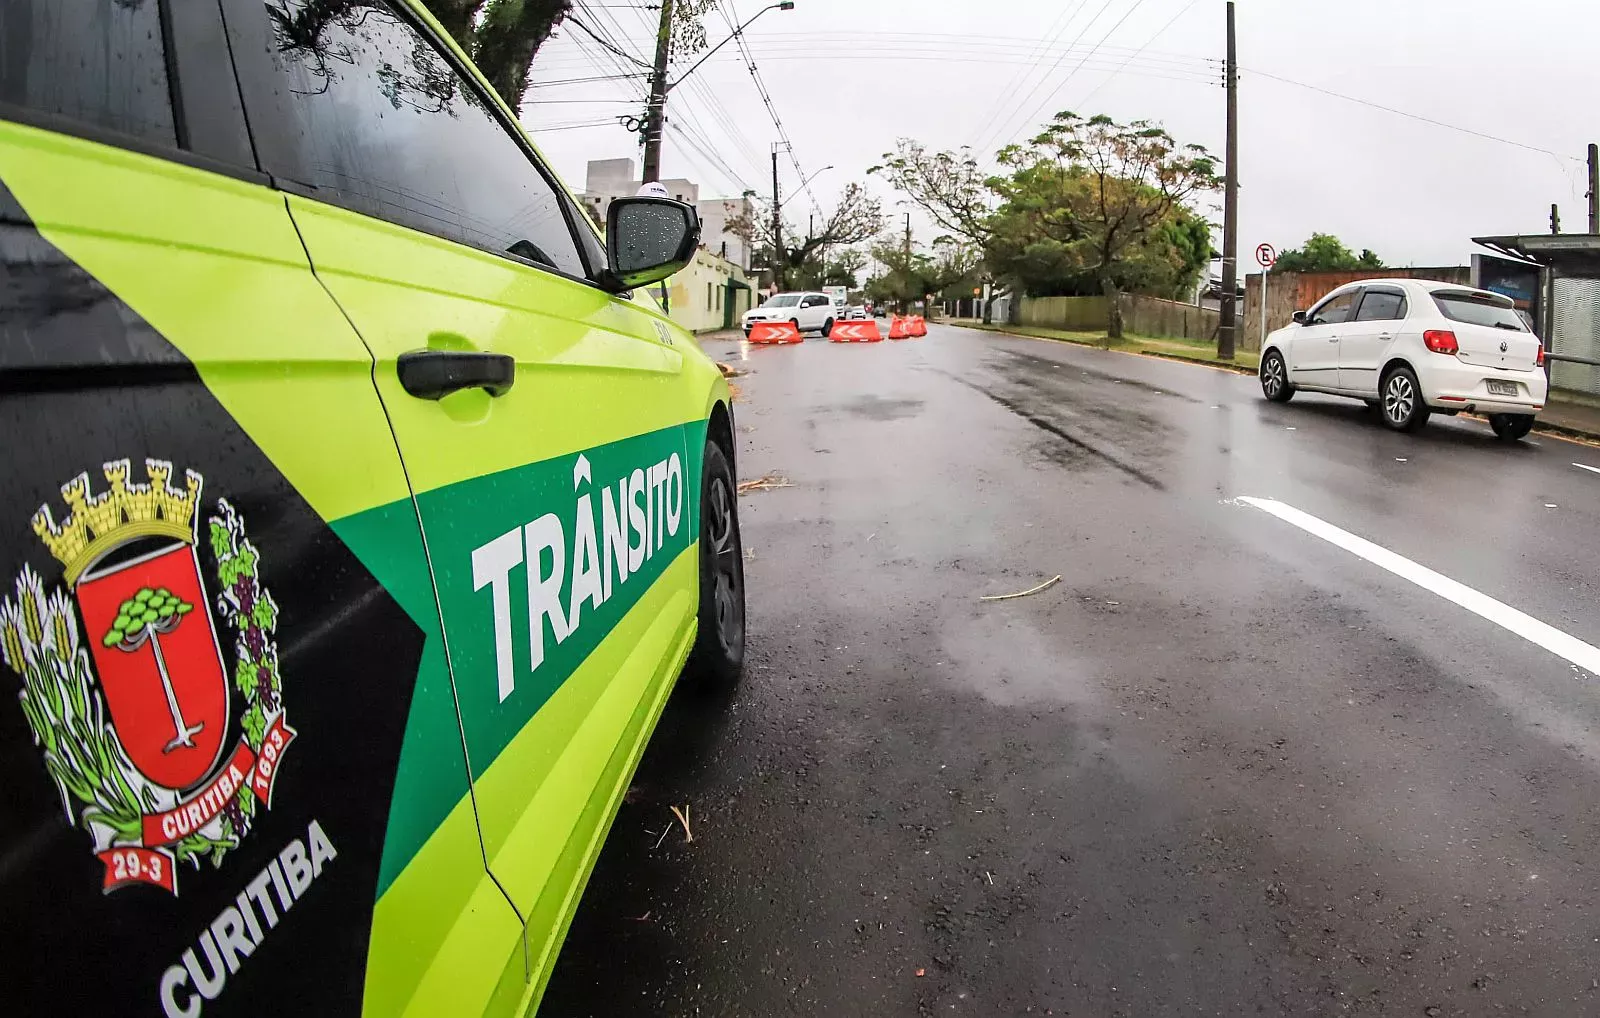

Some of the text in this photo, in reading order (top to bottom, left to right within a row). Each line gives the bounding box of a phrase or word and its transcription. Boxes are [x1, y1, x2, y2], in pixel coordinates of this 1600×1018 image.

[1262, 248, 1270, 261] E
[471, 453, 682, 704] TRÂNSITO
[256, 729, 284, 789] 1693
[162, 764, 243, 840] CURITIBA
[160, 819, 338, 1018] CURITIBA
